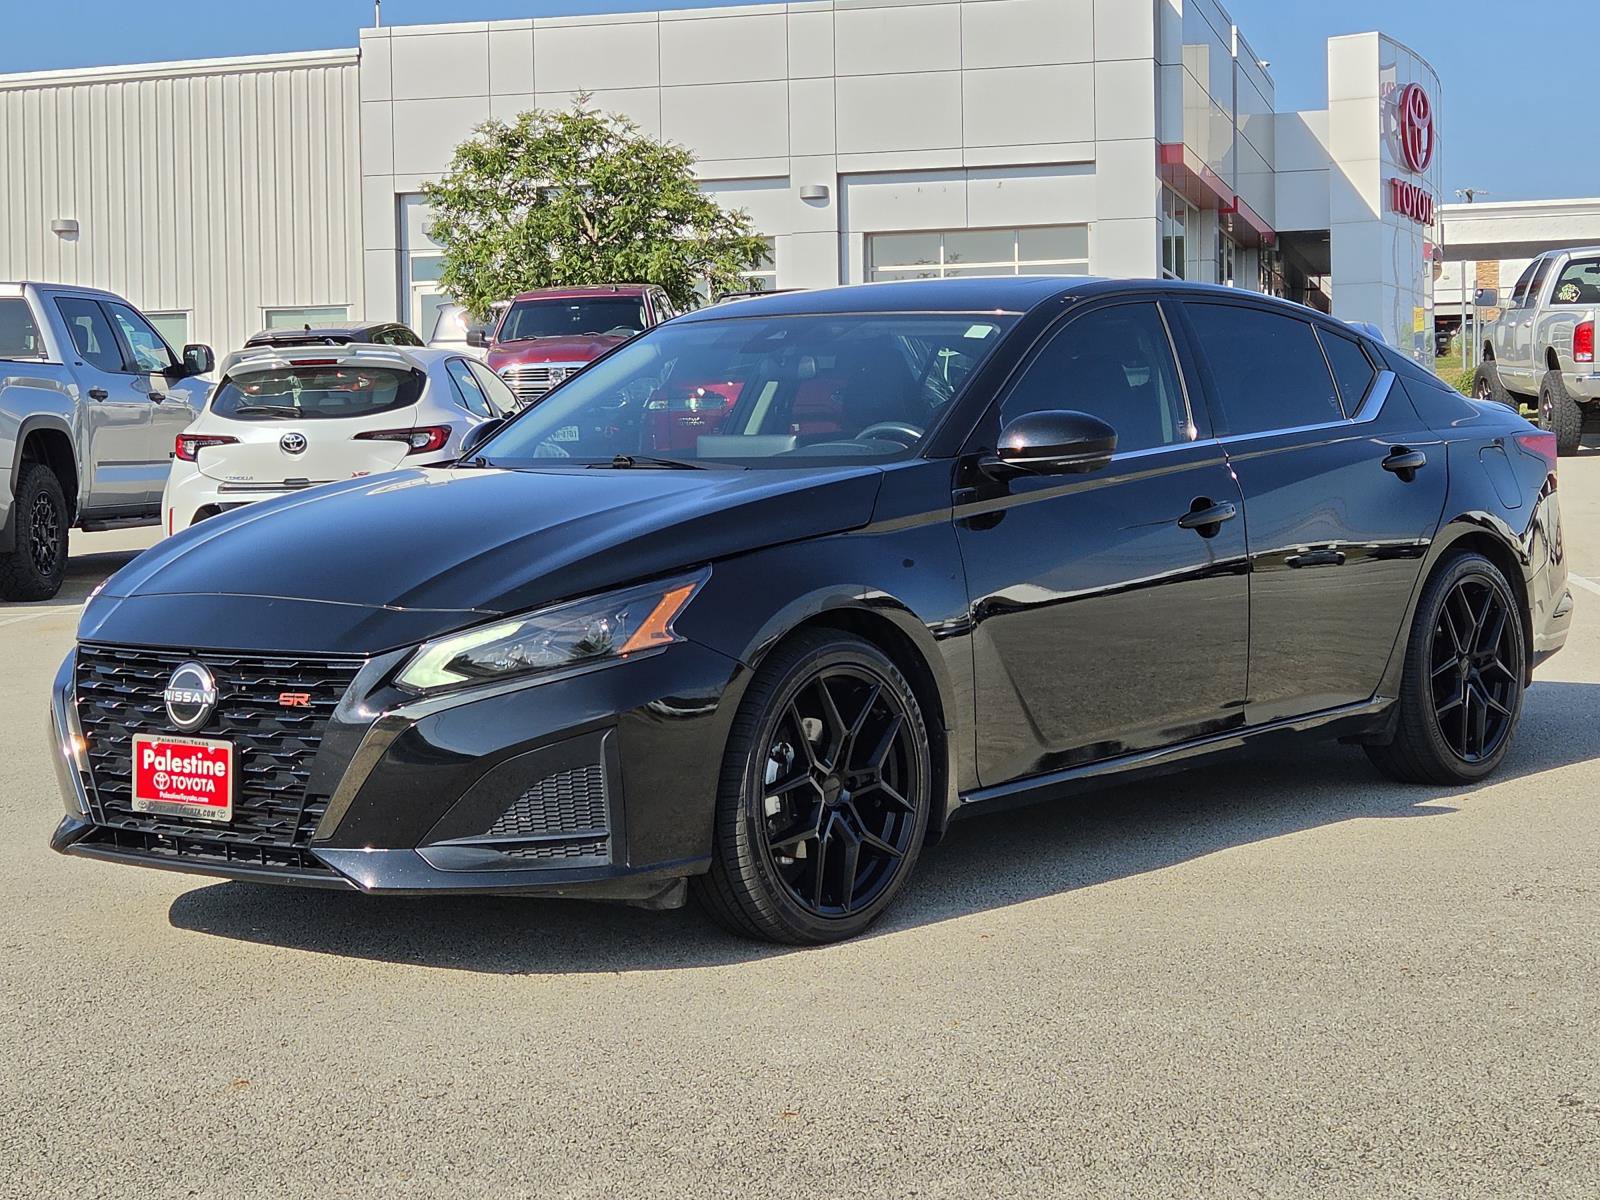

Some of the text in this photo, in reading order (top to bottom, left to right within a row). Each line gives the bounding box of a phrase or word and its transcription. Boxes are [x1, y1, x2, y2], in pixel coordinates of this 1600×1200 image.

[1391, 177, 1435, 227] TOYOTA
[164, 689, 215, 704] NISSAN
[279, 692, 311, 706] SR
[143, 749, 226, 777] Palestine
[171, 775, 216, 793] TOYOTA
